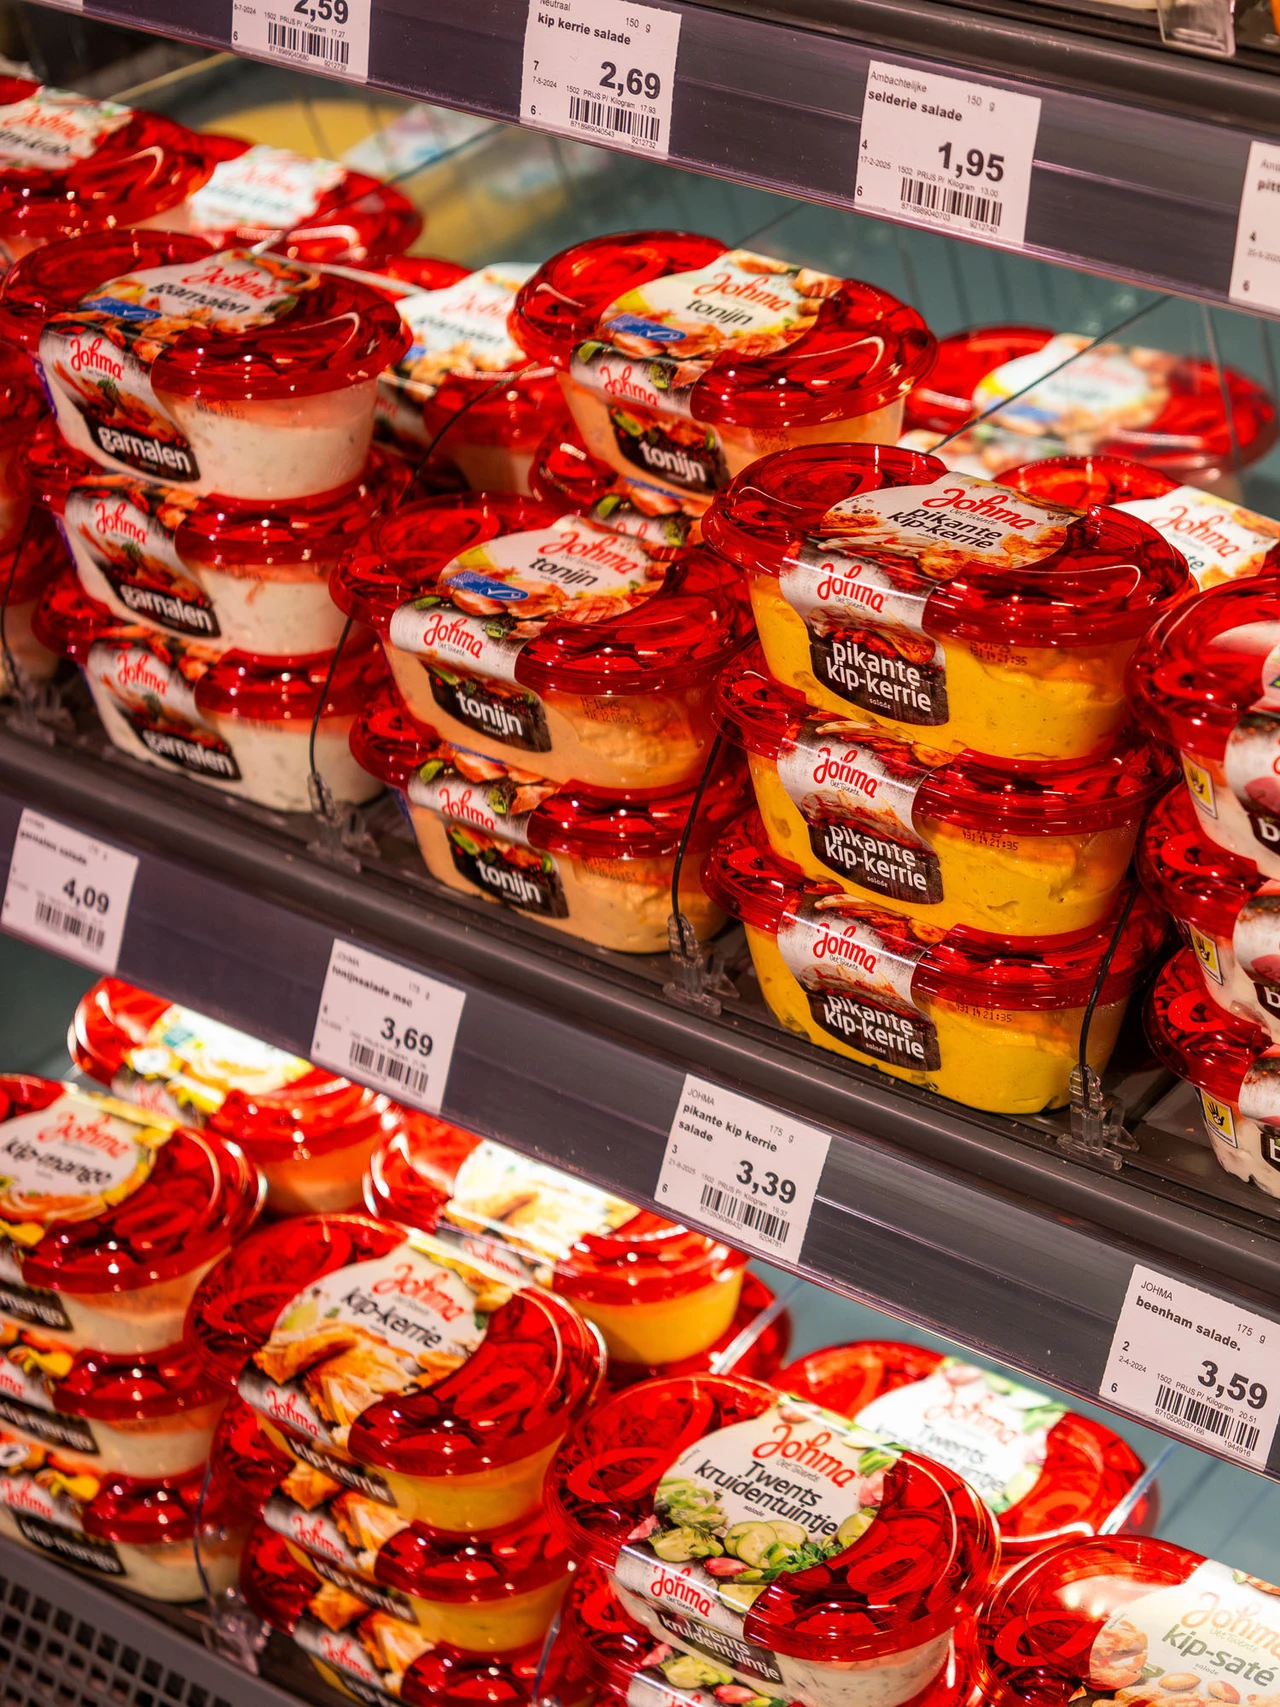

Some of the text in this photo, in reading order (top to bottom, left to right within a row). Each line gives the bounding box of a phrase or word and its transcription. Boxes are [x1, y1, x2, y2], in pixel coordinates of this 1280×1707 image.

[293, 0, 349, 24] 2,59
[538, 12, 632, 45] kip kerrie salade
[626, 17, 651, 33] 150 g
[232, 30, 238, 41] 6
[533, 60, 540, 70] 7
[600, 61, 661, 100] 2,69
[870, 70, 928, 92] Ambachtelijke
[530, 104, 536, 116] 6
[532, 76, 636, 109] 7-5-2024 1502 PRIJS Kilogram
[868, 89, 963, 122] selderie salade
[966, 94, 982, 107] 150
[570, 120, 615, 138] 8718989040543
[862, 139, 868, 150] 4
[916, 169, 975, 192] PRIJS Kilogram
[938, 141, 1005, 182] 1,95
[856, 185, 863, 197] 6
[901, 202, 950, 222] 8718989040703
[148, 282, 254, 315] garnalen
[180, 264, 276, 300] Johma
[694, 272, 791, 314] Johma
[684, 298, 755, 328] tonijn
[70, 336, 124, 381] Johma
[600, 365, 660, 408] Johma
[98, 425, 191, 475] garnalen
[639, 440, 707, 484] tonijn
[95, 502, 148, 544] Johma
[886, 510, 994, 549] kip-kerrie
[908, 506, 1003, 541] pikante
[922, 488, 1038, 530] Johma
[1150, 504, 1241, 558] Johma
[528, 556, 599, 588] tonijn
[538, 530, 640, 576] Johma
[120, 584, 212, 632] garnalen
[816, 562, 886, 614] Johma
[422, 612, 484, 660] Johma
[117, 653, 170, 696] Johma
[824, 655, 932, 713] kip-kerrie
[832, 640, 920, 687] pikante
[454, 690, 523, 737] tonijn
[143, 727, 234, 777] garnalen
[812, 747, 882, 799] Johma
[439, 788, 497, 831] Johma
[824, 836, 928, 892] kip-kerrie
[828, 824, 916, 867] pikante
[990, 838, 1018, 850] 21:35
[62, 878, 110, 914] 4,09
[476, 858, 542, 904] tonijn
[812, 924, 880, 975] Johma
[380, 1016, 434, 1057] 3,69
[823, 1004, 926, 1060] kip-kerrie
[828, 994, 914, 1037] pikante
[984, 1010, 1012, 1022] 21:35
[687, 1088, 715, 1106] JOHMA
[36, 1114, 132, 1159] Johma
[672, 1144, 678, 1154] 3
[678, 1119, 714, 1142] salade
[682, 1103, 778, 1154] pikante kip kerrie
[770, 1124, 794, 1144] 175 g
[2, 1138, 112, 1184] kip-mango
[736, 1160, 796, 1204] 3,39
[662, 1183, 668, 1193] 6
[744, 1192, 788, 1218] Kilogram 19,37
[372, 1264, 464, 1322] Johma
[1140, 1280, 1173, 1301] JOHMA
[340, 1287, 442, 1349] kip-kerrie
[1136, 1295, 1241, 1352] beenham salade.
[1237, 1322, 1266, 1344] 175 g
[1122, 1341, 1130, 1352] 2
[1110, 1382, 1118, 1394] 6
[1118, 1355, 1257, 1424] 2-4-2024 1502 PRIJS Kilogram 20,51
[1197, 1360, 1268, 1410] 3,59
[266, 1388, 320, 1437] Johma
[1155, 1408, 1206, 1436] 8710506037166
[754, 1424, 858, 1489] Johma
[1224, 1440, 1251, 1458] 1944916
[694, 1458, 840, 1536] kruidentuintje
[749, 1460, 822, 1508] Twents
[292, 1516, 345, 1563] Johma
[650, 1564, 711, 1620] Johma
[660, 1614, 780, 1681] kruidentuintje
[1160, 1624, 1276, 1688] kip-saté
